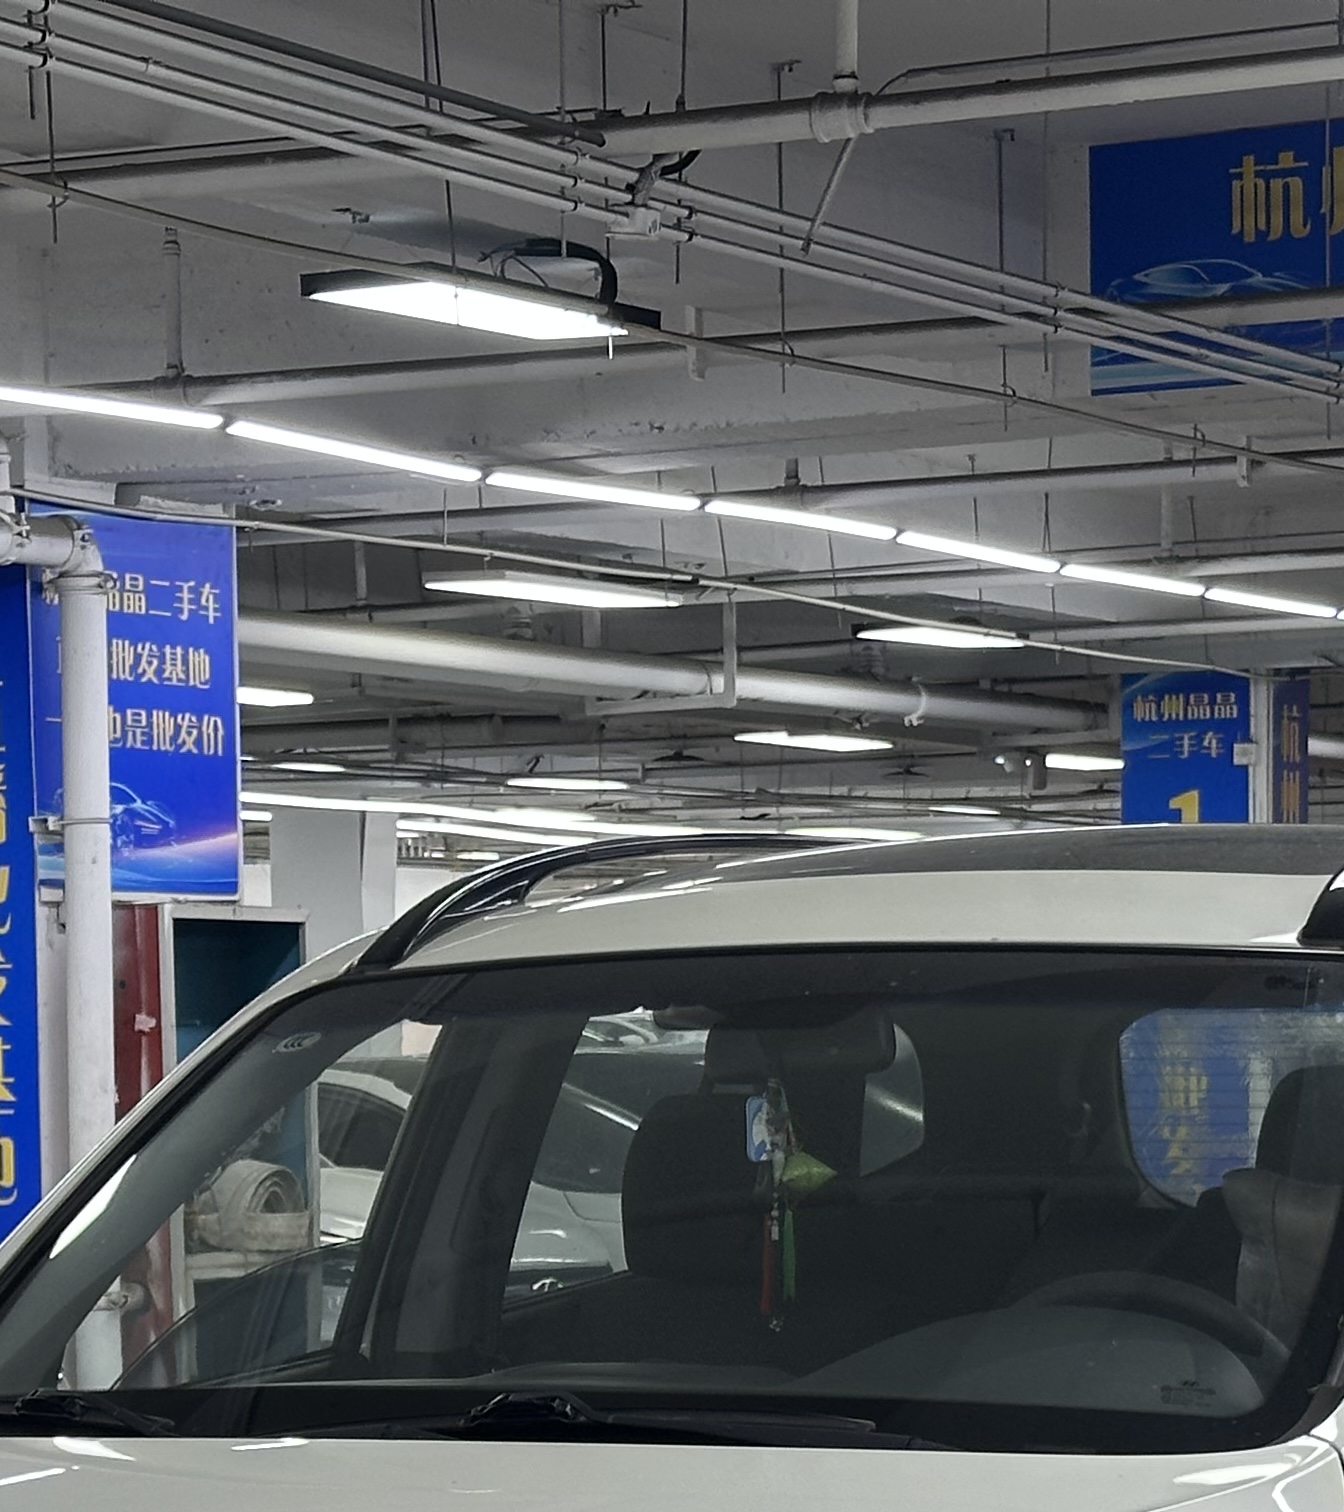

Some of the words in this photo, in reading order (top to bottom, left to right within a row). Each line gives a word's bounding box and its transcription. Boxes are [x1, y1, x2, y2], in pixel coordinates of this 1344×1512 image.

[57, 638, 210, 689] 批发基地
[1133, 693, 1238, 722] 杭州晶晶
[1148, 732, 1224, 759] 二手车
[1170, 790, 1199, 823] 1
